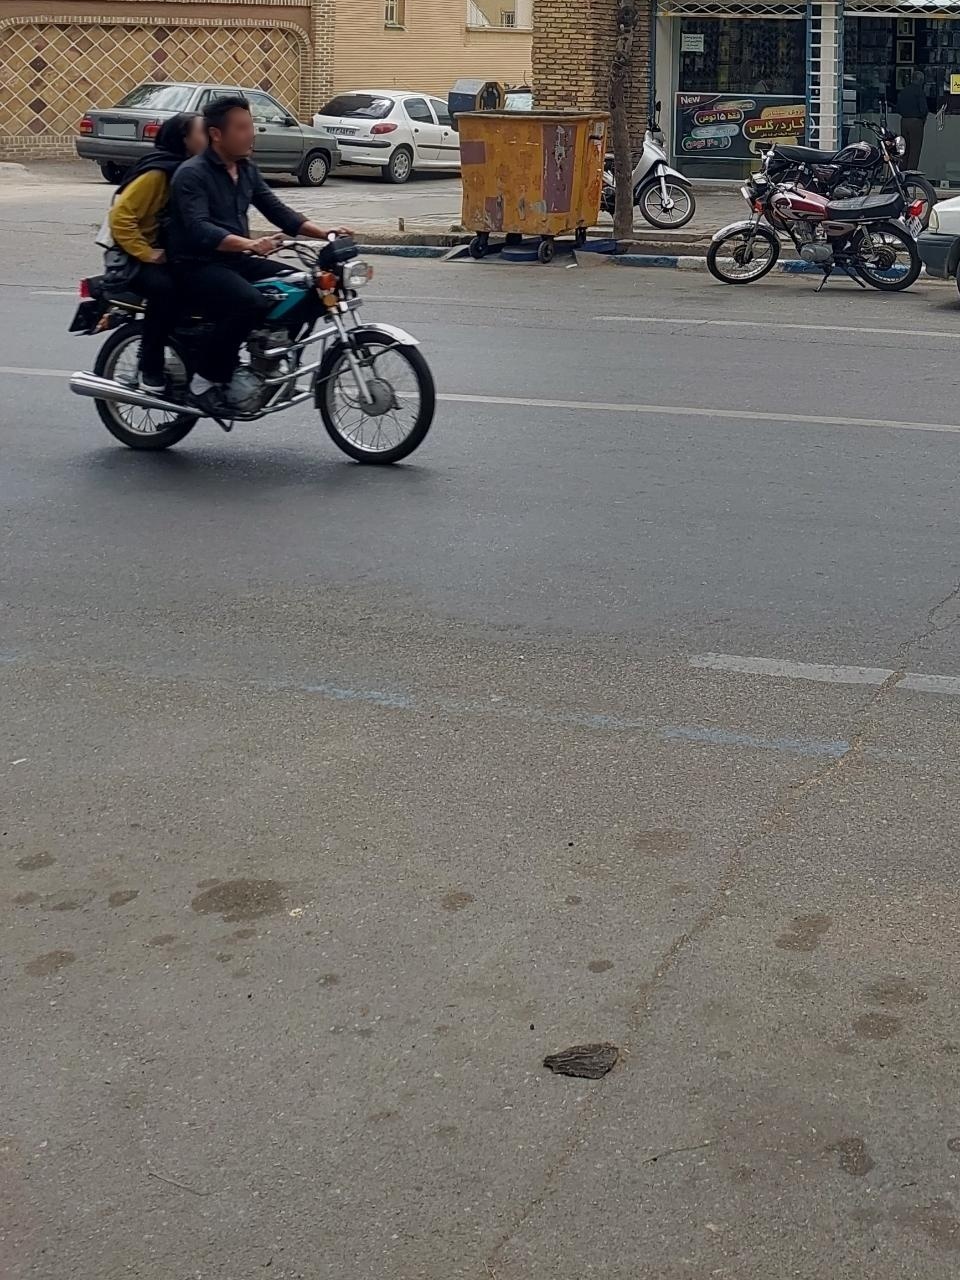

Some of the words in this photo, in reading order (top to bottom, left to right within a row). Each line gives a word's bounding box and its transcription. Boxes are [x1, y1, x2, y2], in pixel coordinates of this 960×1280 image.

[680, 96, 701, 105] New
[698, 113, 717, 123] تومن
[727, 111, 741, 120] فقط
